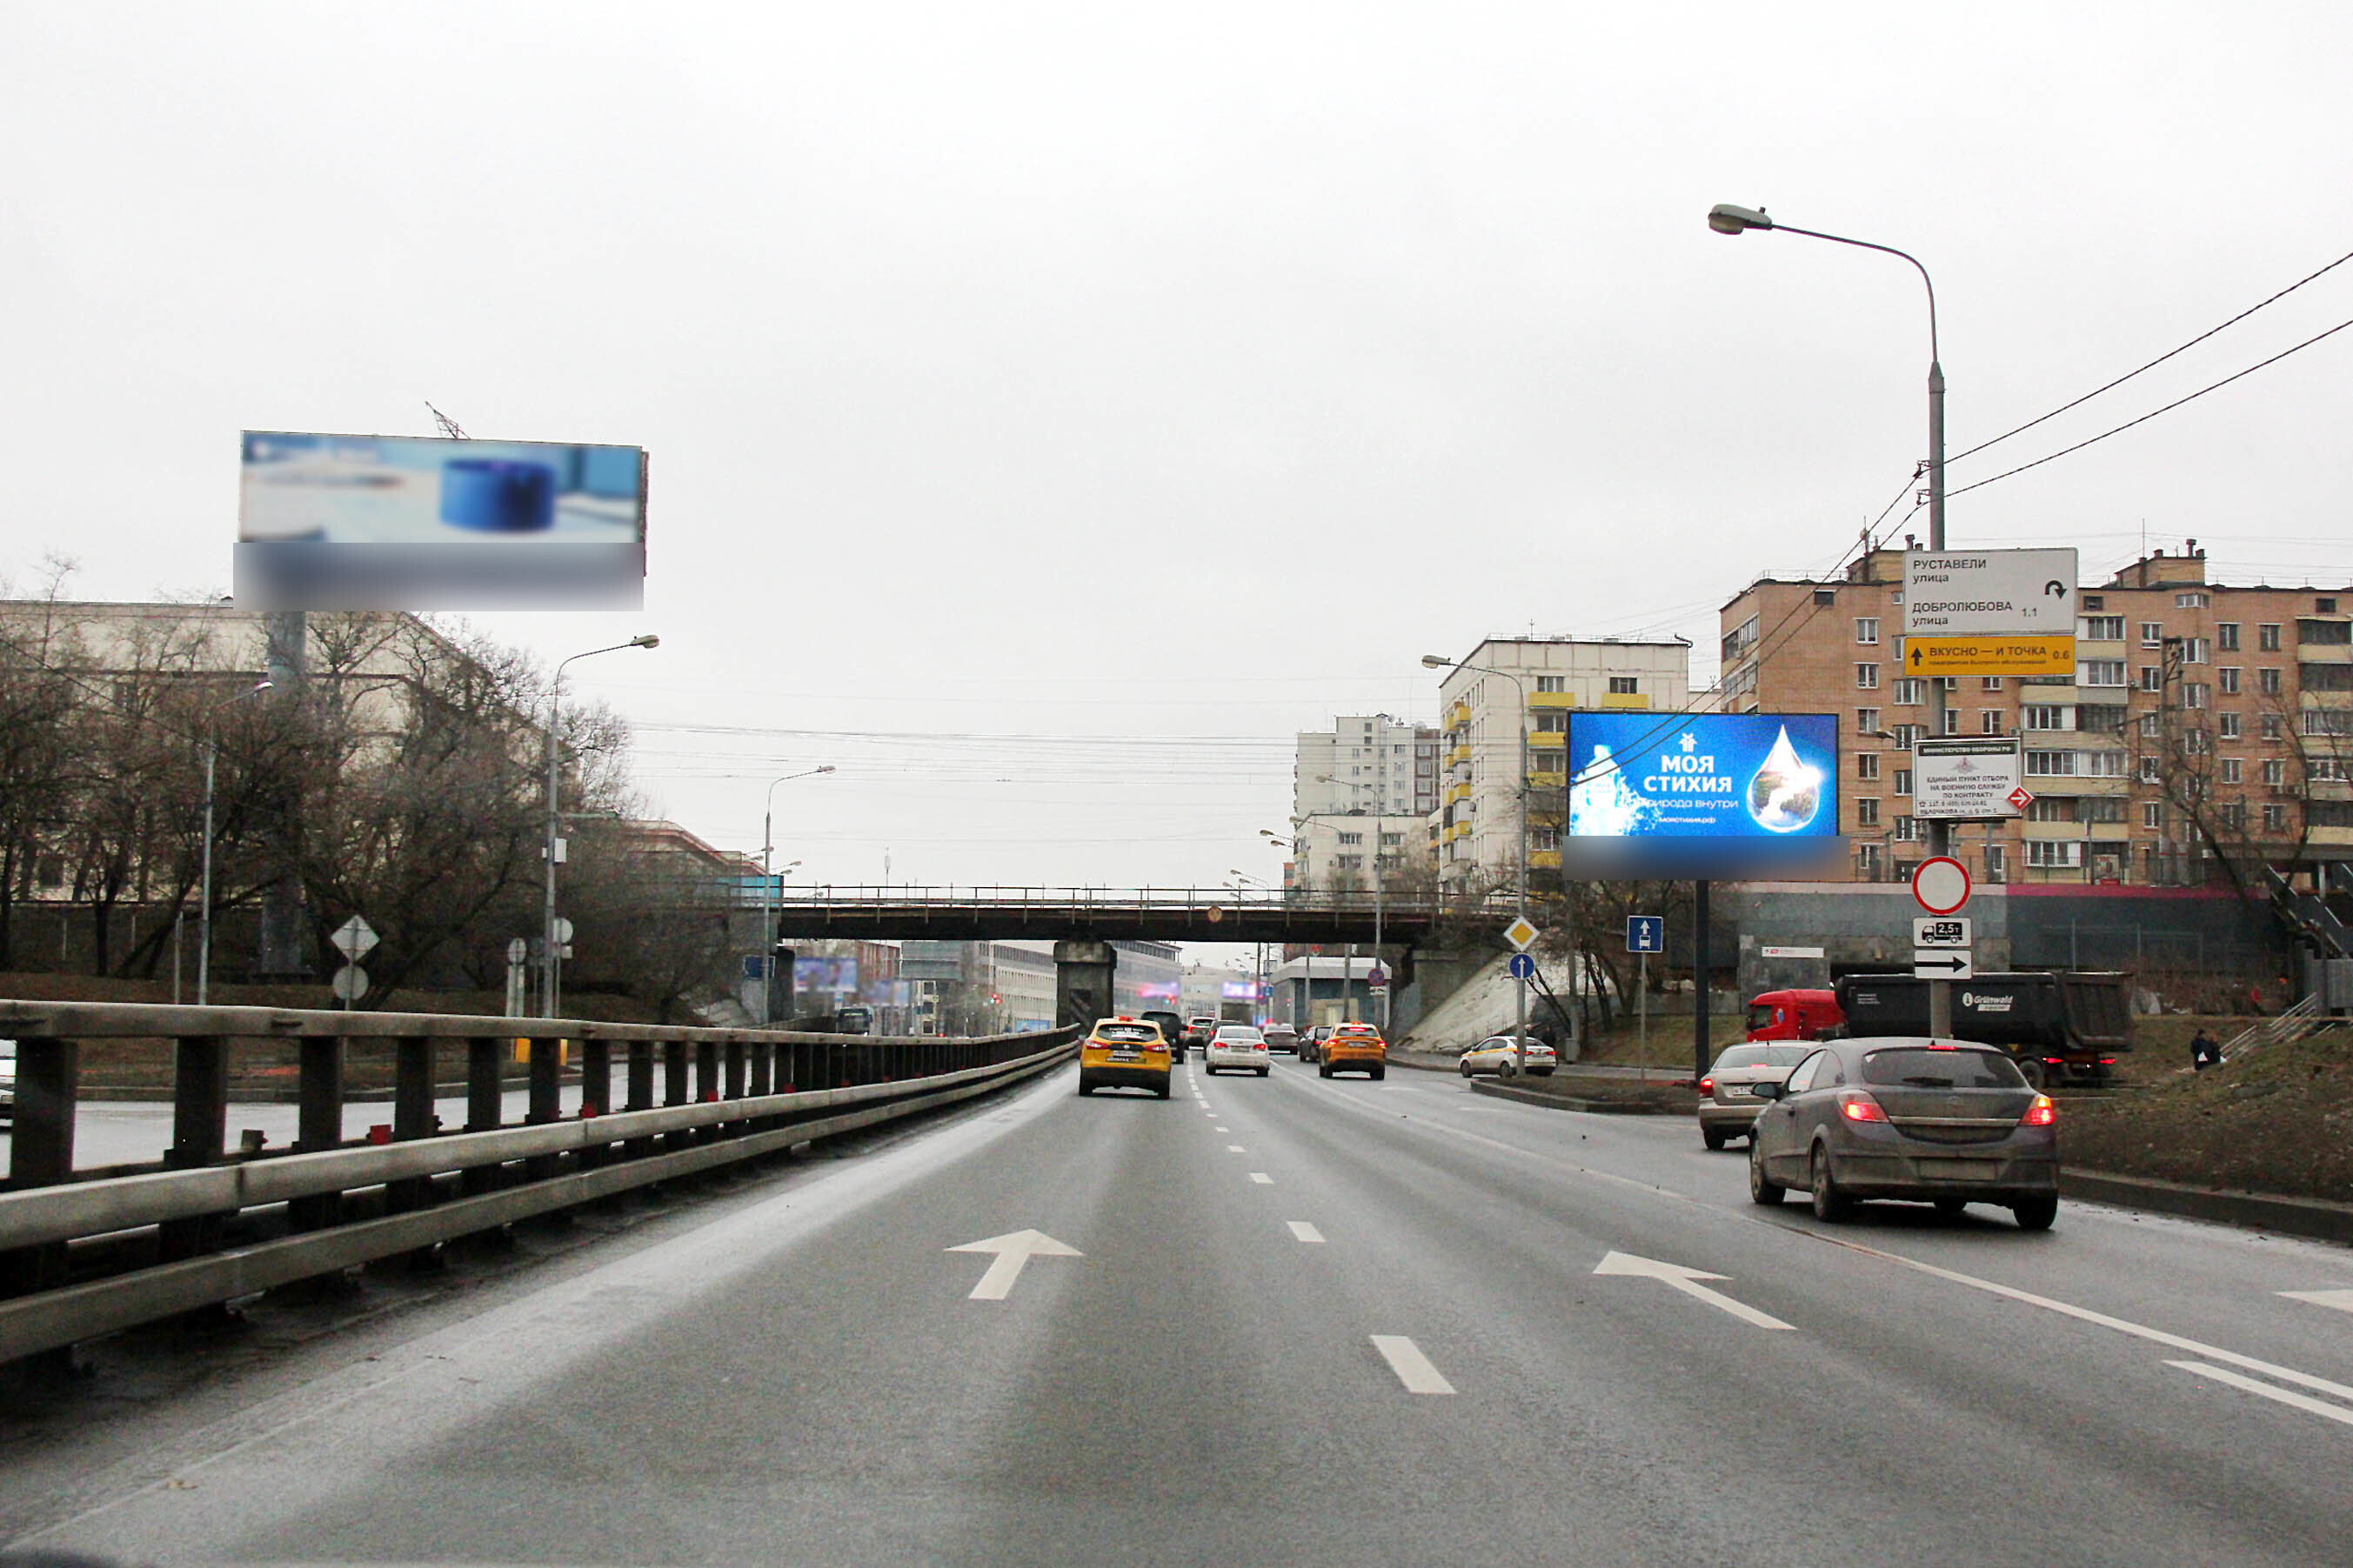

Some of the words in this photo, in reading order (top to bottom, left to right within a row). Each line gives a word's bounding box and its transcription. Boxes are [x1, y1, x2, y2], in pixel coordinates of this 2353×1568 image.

[1913, 559, 1986, 570] РУСТАВЕЛИ
[1913, 574, 1949, 584] улица
[1912, 602, 2013, 613] ДОБРОЛЮБОВА
[2022, 608, 2037, 617] 1.1
[1912, 617, 1949, 627] улица
[1929, 647, 1978, 657] ВКУСНО
[1996, 647, 2004, 656] И
[2008, 646, 2047, 656] ТОЧКА
[2053, 651, 2069, 659] 0.6
[1661, 755, 1714, 773] МОЯ
[1643, 776, 1732, 792] СТИХИЯ
[1695, 799, 1739, 810] внутри
